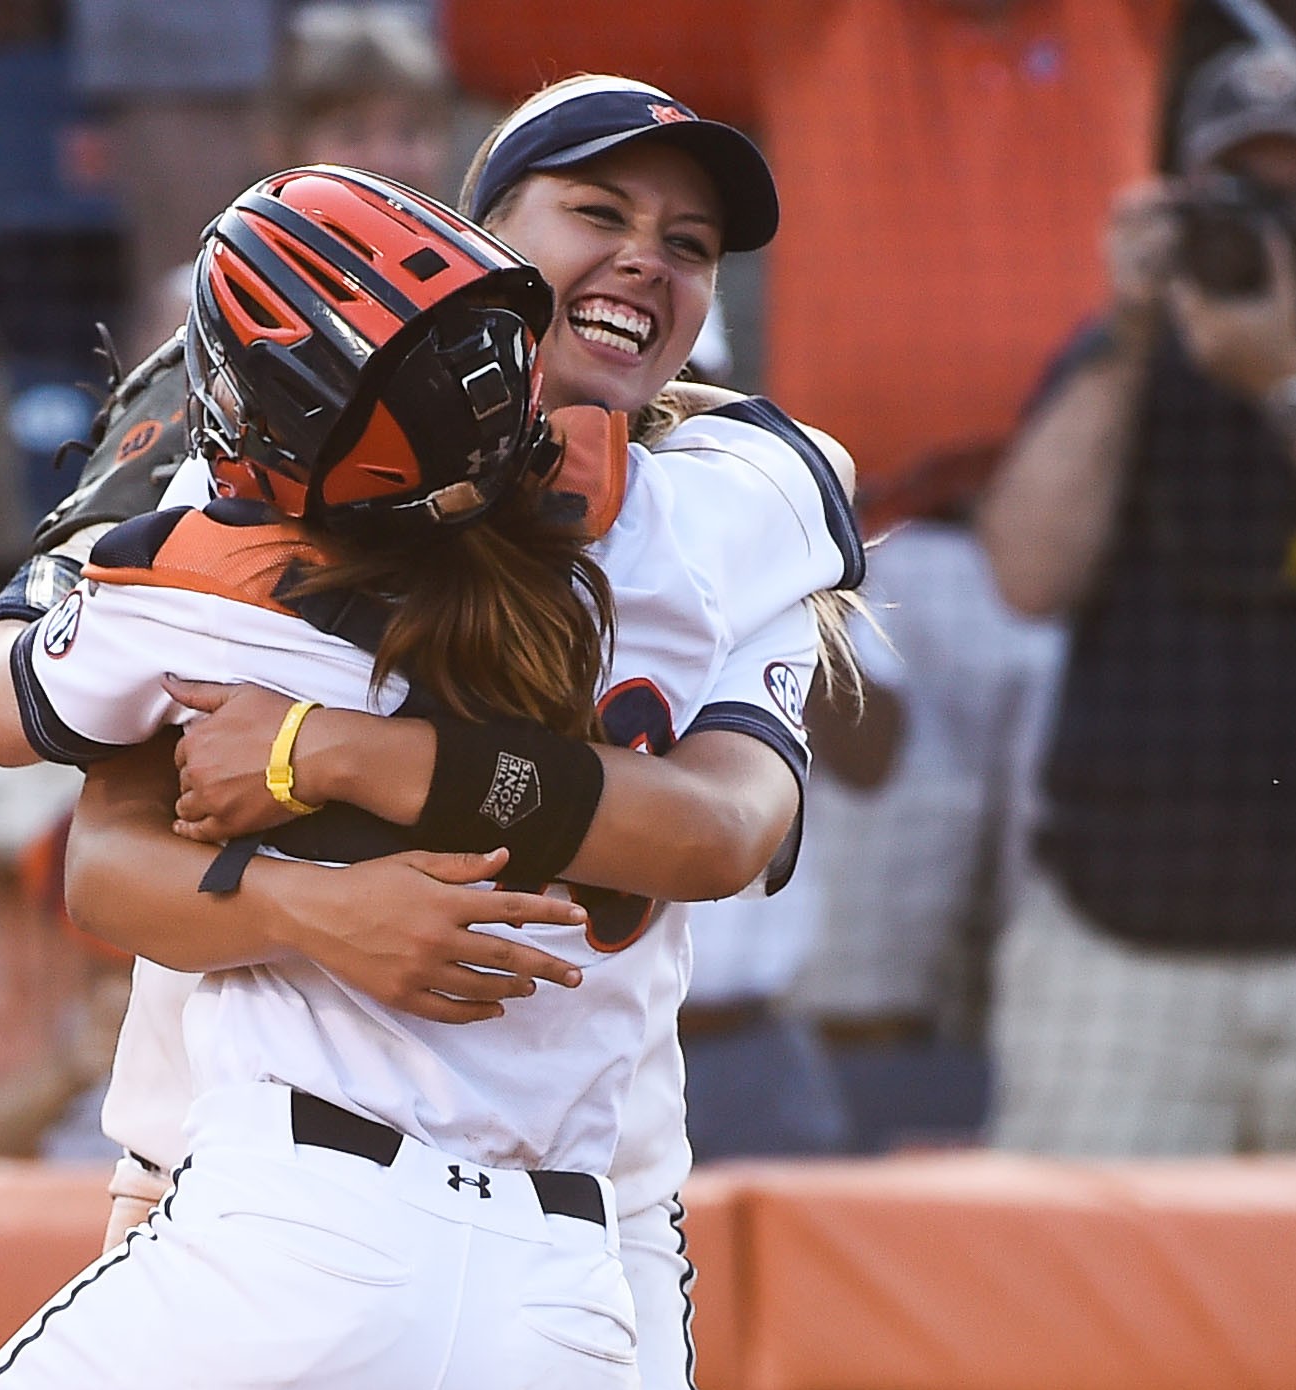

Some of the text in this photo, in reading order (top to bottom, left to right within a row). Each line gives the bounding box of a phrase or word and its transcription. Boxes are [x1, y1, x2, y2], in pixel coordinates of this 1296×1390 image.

[483, 756, 509, 814] OWN THE
[494, 759, 521, 818] ZONE
[500, 763, 532, 825] SPORTS
